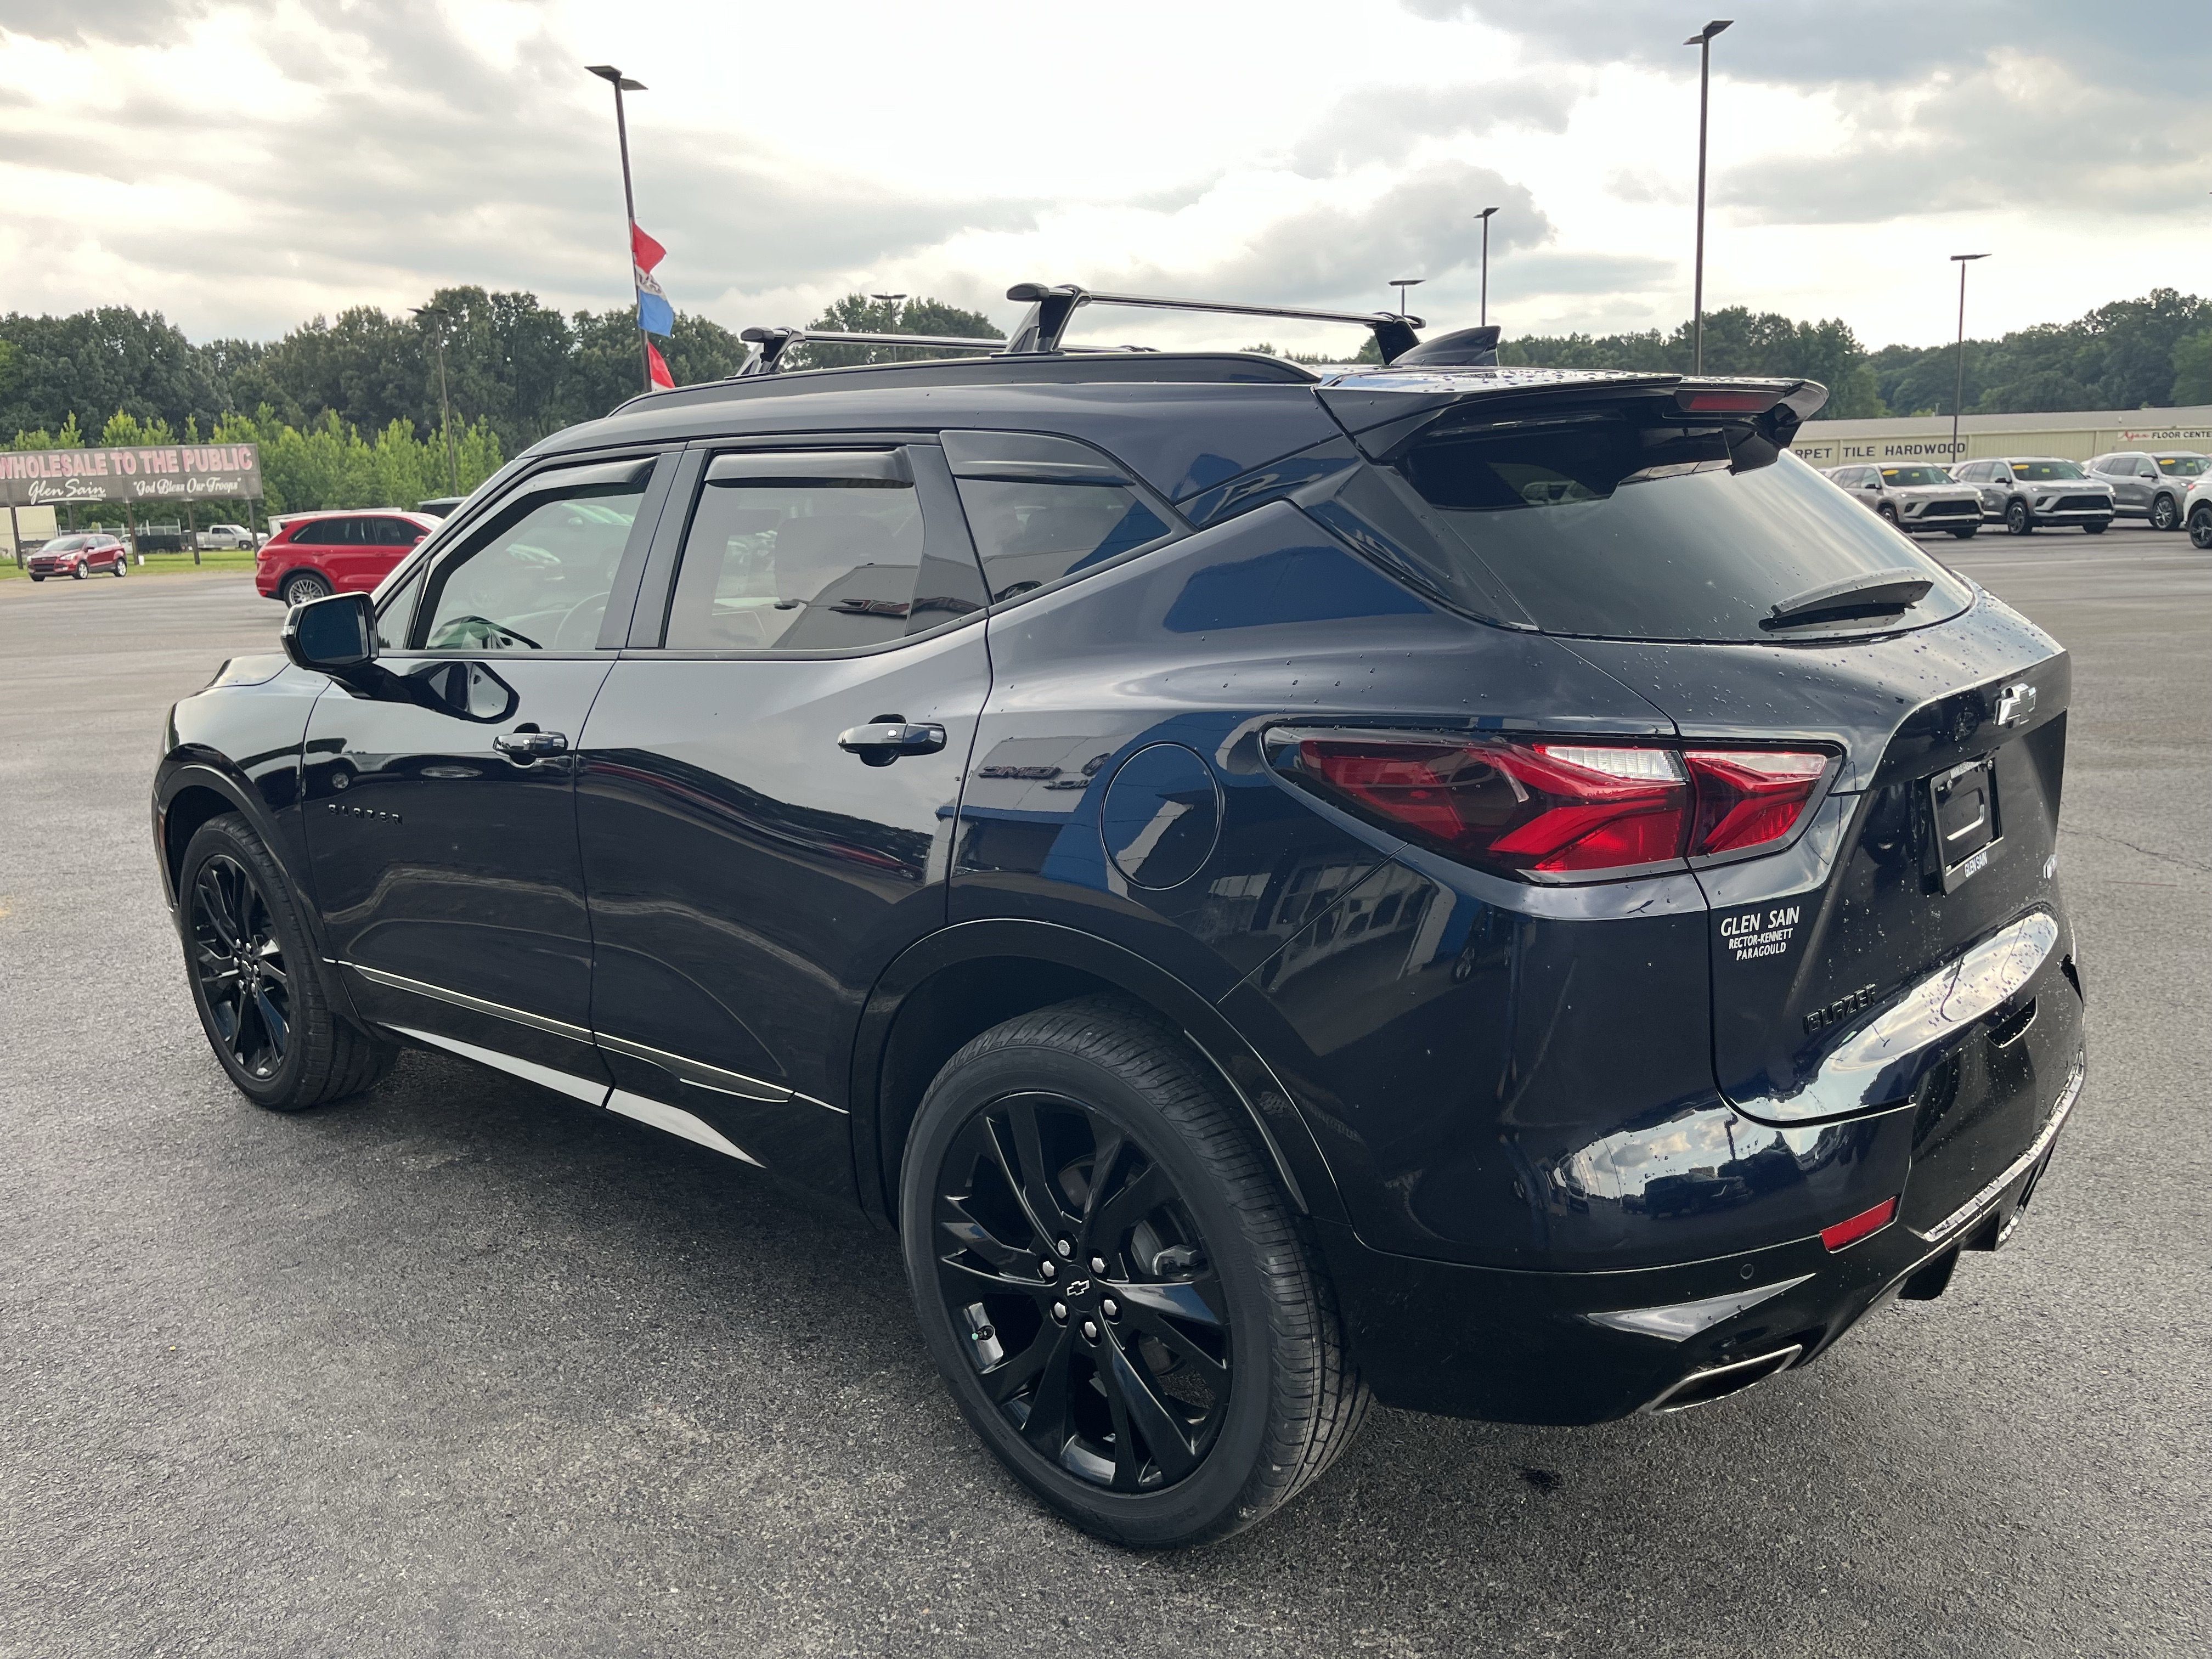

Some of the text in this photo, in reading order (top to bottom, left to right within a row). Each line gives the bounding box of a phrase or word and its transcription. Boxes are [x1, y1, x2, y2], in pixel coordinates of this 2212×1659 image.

[1795, 443, 1966, 459] RPET TILE HARDWOOD
[0, 447, 253, 480] WHOLESALE TO THE PUBLIC
[29, 478, 106, 505] Glen Sain
[157, 478, 185, 494] Bless
[187, 477, 205, 493] Our
[328, 804, 403, 825] BLAZER
[1964, 851, 1988, 878] GLEN SAIN
[1720, 906, 1800, 937] GLEN SAIN
[1729, 928, 1793, 950] RECTOR-KENNETT
[1736, 942, 1787, 961] PARAGOULD
